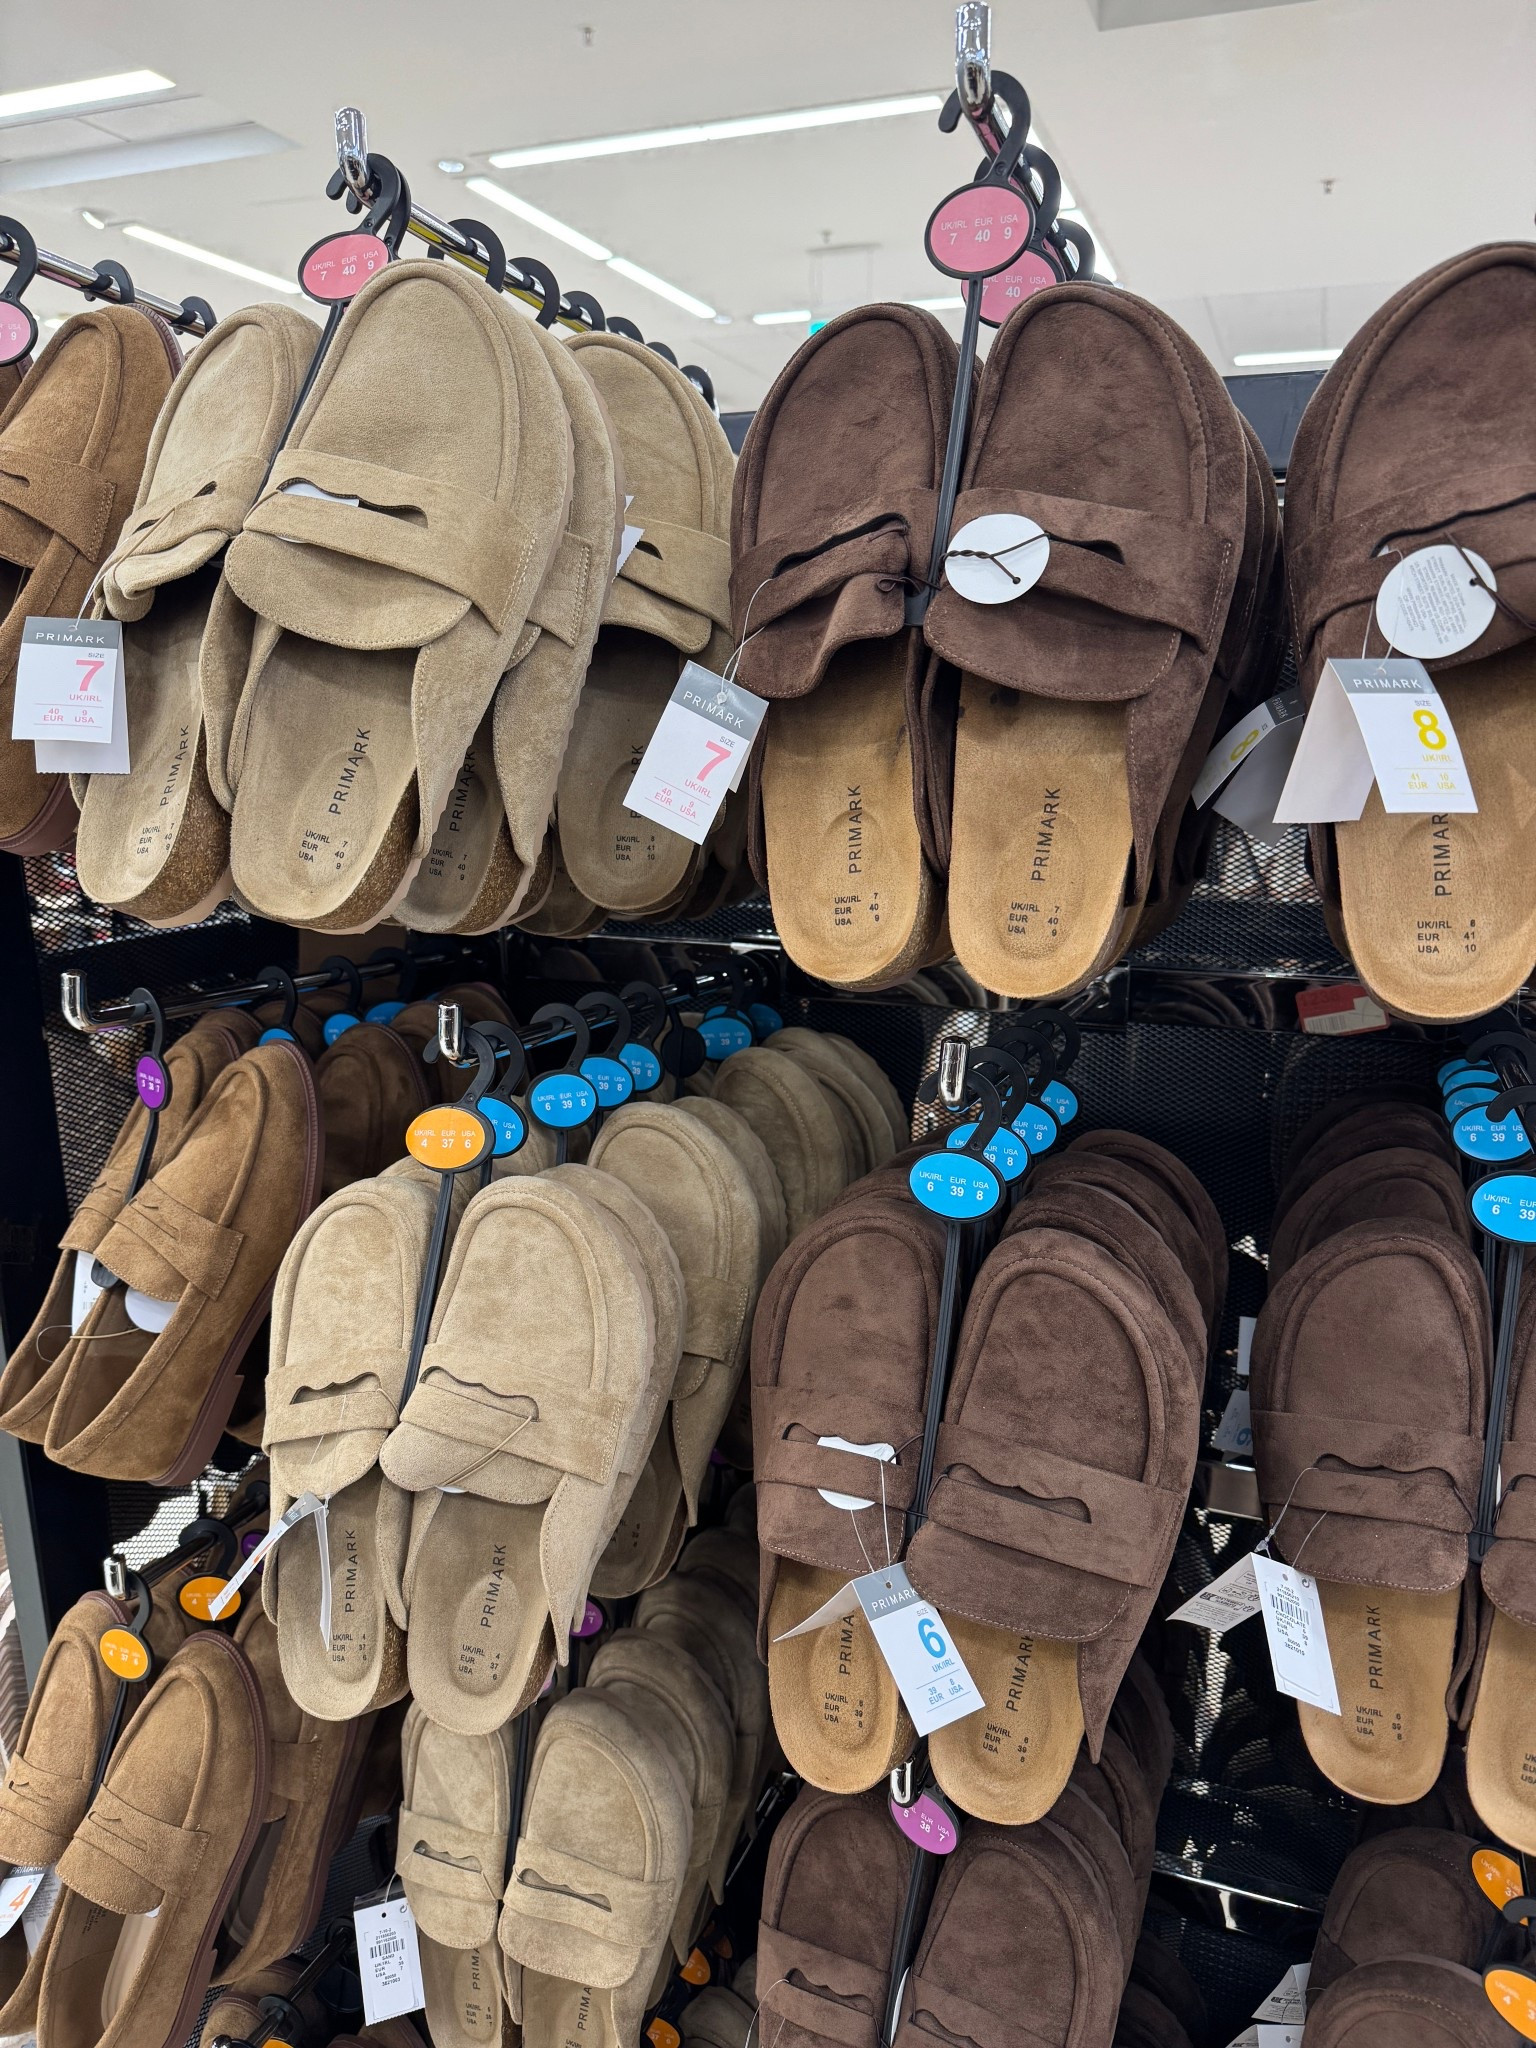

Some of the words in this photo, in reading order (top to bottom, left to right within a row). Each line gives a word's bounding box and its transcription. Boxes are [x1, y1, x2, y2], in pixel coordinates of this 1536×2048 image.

[941, 220, 968, 231] UK/IRL
[974, 217, 993, 227] EUR
[1000, 214, 1018, 224] USA
[949, 233, 957, 245] 7
[975, 229, 991, 243] 40
[1004, 226, 1012, 240] 9
[312, 260, 336, 271] UK/IRL
[341, 255, 358, 265] EUR
[363, 250, 379, 259] USA
[320, 271, 327, 280] 7
[342, 264, 356, 276] 40
[367, 260, 374, 270] 9
[1005, 276, 1023, 284] EUR
[1029, 277, 1047, 285] USA
[1005, 286, 1021, 298] 40
[35, 632, 105, 644] PRIMARK
[75, 659, 105, 692] 7
[1353, 678, 1422, 689] PRIMARK
[69, 694, 102, 702] UK/IRL
[683, 690, 745, 729] PRIMARK
[43, 714, 64, 722] EUR
[74, 716, 94, 724] USA
[1412, 709, 1447, 751] 8
[719, 736, 735, 748] SIZE
[1230, 729, 1260, 762] 8
[160, 724, 189, 807] PRIMARK
[696, 739, 732, 782] 7
[328, 727, 371, 815] PRIMARK
[449, 750, 476, 832] PRIMARK
[661, 787, 672, 796] 40
[685, 778, 712, 798] UK/IRL
[1408, 781, 1428, 789] EUR
[1437, 781, 1456, 790] USA
[654, 792, 673, 806] EUR
[680, 804, 697, 819] USA
[847, 785, 862, 874] PRIMARK
[1030, 787, 1061, 882] PRIMARK
[139, 836, 153, 845] EUR
[164, 833, 173, 841] 40
[305, 829, 330, 845] UK/IRL
[342, 840, 348, 848] 7
[616, 835, 640, 843] UK/IRL
[136, 847, 149, 855] USA
[301, 840, 319, 852] EUR
[334, 850, 345, 860] 40
[615, 844, 631, 852] EUR
[298, 850, 315, 863] USA
[335, 862, 342, 870] 9
[615, 853, 631, 861] USA
[834, 895, 862, 904] UK/IRL
[873, 892, 879, 900] 7
[834, 907, 852, 915] EUR
[869, 903, 879, 911] 40
[1010, 901, 1041, 913] UK/IRL
[1054, 906, 1060, 914] 7
[834, 918, 852, 926] USA
[874, 914, 880, 923] 9
[1009, 913, 1028, 923] EUR
[1047, 916, 1059, 925] 40
[1417, 920, 1452, 929] UK/IRL
[1007, 925, 1027, 935] USA
[1051, 928, 1057, 937] 9
[1417, 933, 1440, 941] EUR
[1463, 931, 1476, 940] 41
[1417, 945, 1440, 954] USA
[1464, 944, 1477, 953] 10
[632, 1067, 641, 1075] 39
[598, 1081, 609, 1090] 39
[617, 1083, 623, 1092] 8
[537, 1094, 556, 1102] UK/IRL
[559, 1092, 573, 1100] EUR
[575, 1090, 589, 1098] USA
[1056, 1097, 1070, 1105] USA
[545, 1102, 552, 1112] 6
[562, 1100, 573, 1109] 39
[580, 1098, 587, 1107] 8
[1059, 1105, 1065, 1114] 8
[503, 1121, 516, 1130] USA
[1033, 1123, 1048, 1131] USA
[1461, 1124, 1486, 1132] UK/IRL
[1490, 1124, 1507, 1132] EUR
[505, 1130, 512, 1140] 8
[1036, 1131, 1043, 1141] 8
[1469, 1133, 1477, 1142] 6
[1492, 1133, 1505, 1142] 39
[1516, 1133, 1524, 1142] 8
[420, 1138, 428, 1148] 4
[441, 1138, 454, 1149] 37
[464, 1138, 472, 1149] 6
[1003, 1147, 1019, 1157] USA
[1007, 1157, 1014, 1166] 8
[919, 1170, 944, 1182] UK/IRL
[950, 1176, 967, 1186] EUR
[973, 1180, 990, 1190] USA
[927, 1182, 934, 1192] 6
[950, 1185, 965, 1197] 39
[976, 1191, 984, 1201] 8
[1483, 1193, 1513, 1205] UK/IRL
[1491, 1204, 1501, 1215] 6
[1519, 1209, 1536, 1221] 39
[344, 1529, 358, 1613] PRIMARK
[480, 1543, 507, 1629] PRIMARK
[871, 1587, 919, 1613] PRIMARK
[916, 1607, 930, 1618] SIZE
[332, 1633, 354, 1642] UK/IRL
[917, 1617, 947, 1659] 6
[332, 1644, 346, 1652] EUR
[358, 1643, 366, 1651] 37
[461, 1644, 486, 1657] UK/IRL
[1366, 1604, 1384, 1691] PRIMARK
[332, 1654, 346, 1662] USA
[460, 1654, 476, 1665] EUR
[489, 1662, 499, 1671] 37
[458, 1665, 474, 1675] USA
[931, 1658, 956, 1673] UK/IRL
[928, 1686, 938, 1696] 39
[928, 1692, 945, 1705] EUR
[948, 1683, 964, 1696] USA
[825, 1692, 849, 1704] UK/IRL
[824, 1702, 840, 1713] EUR
[1355, 1705, 1384, 1718] UK/IRL
[824, 1713, 839, 1724] USA
[1356, 1716, 1374, 1726] EUR
[986, 1722, 1012, 1738] UK/IRL
[1356, 1726, 1375, 1737] USA
[984, 1732, 1001, 1744] EUR
[982, 1741, 999, 1754] USA
[903, 1809, 909, 1818] 5
[920, 1820, 931, 1833] 38
[939, 1833, 945, 1842] 7
[920, 1812, 934, 1825] EUR
[937, 1824, 950, 1837] USA
[1485, 1872, 1493, 1881] 4
[9, 1884, 33, 1912] 4
[381, 1953, 395, 1961] SAND
[1503, 1995, 1512, 2005] 4
[577, 1987, 592, 2031] PRIMA
